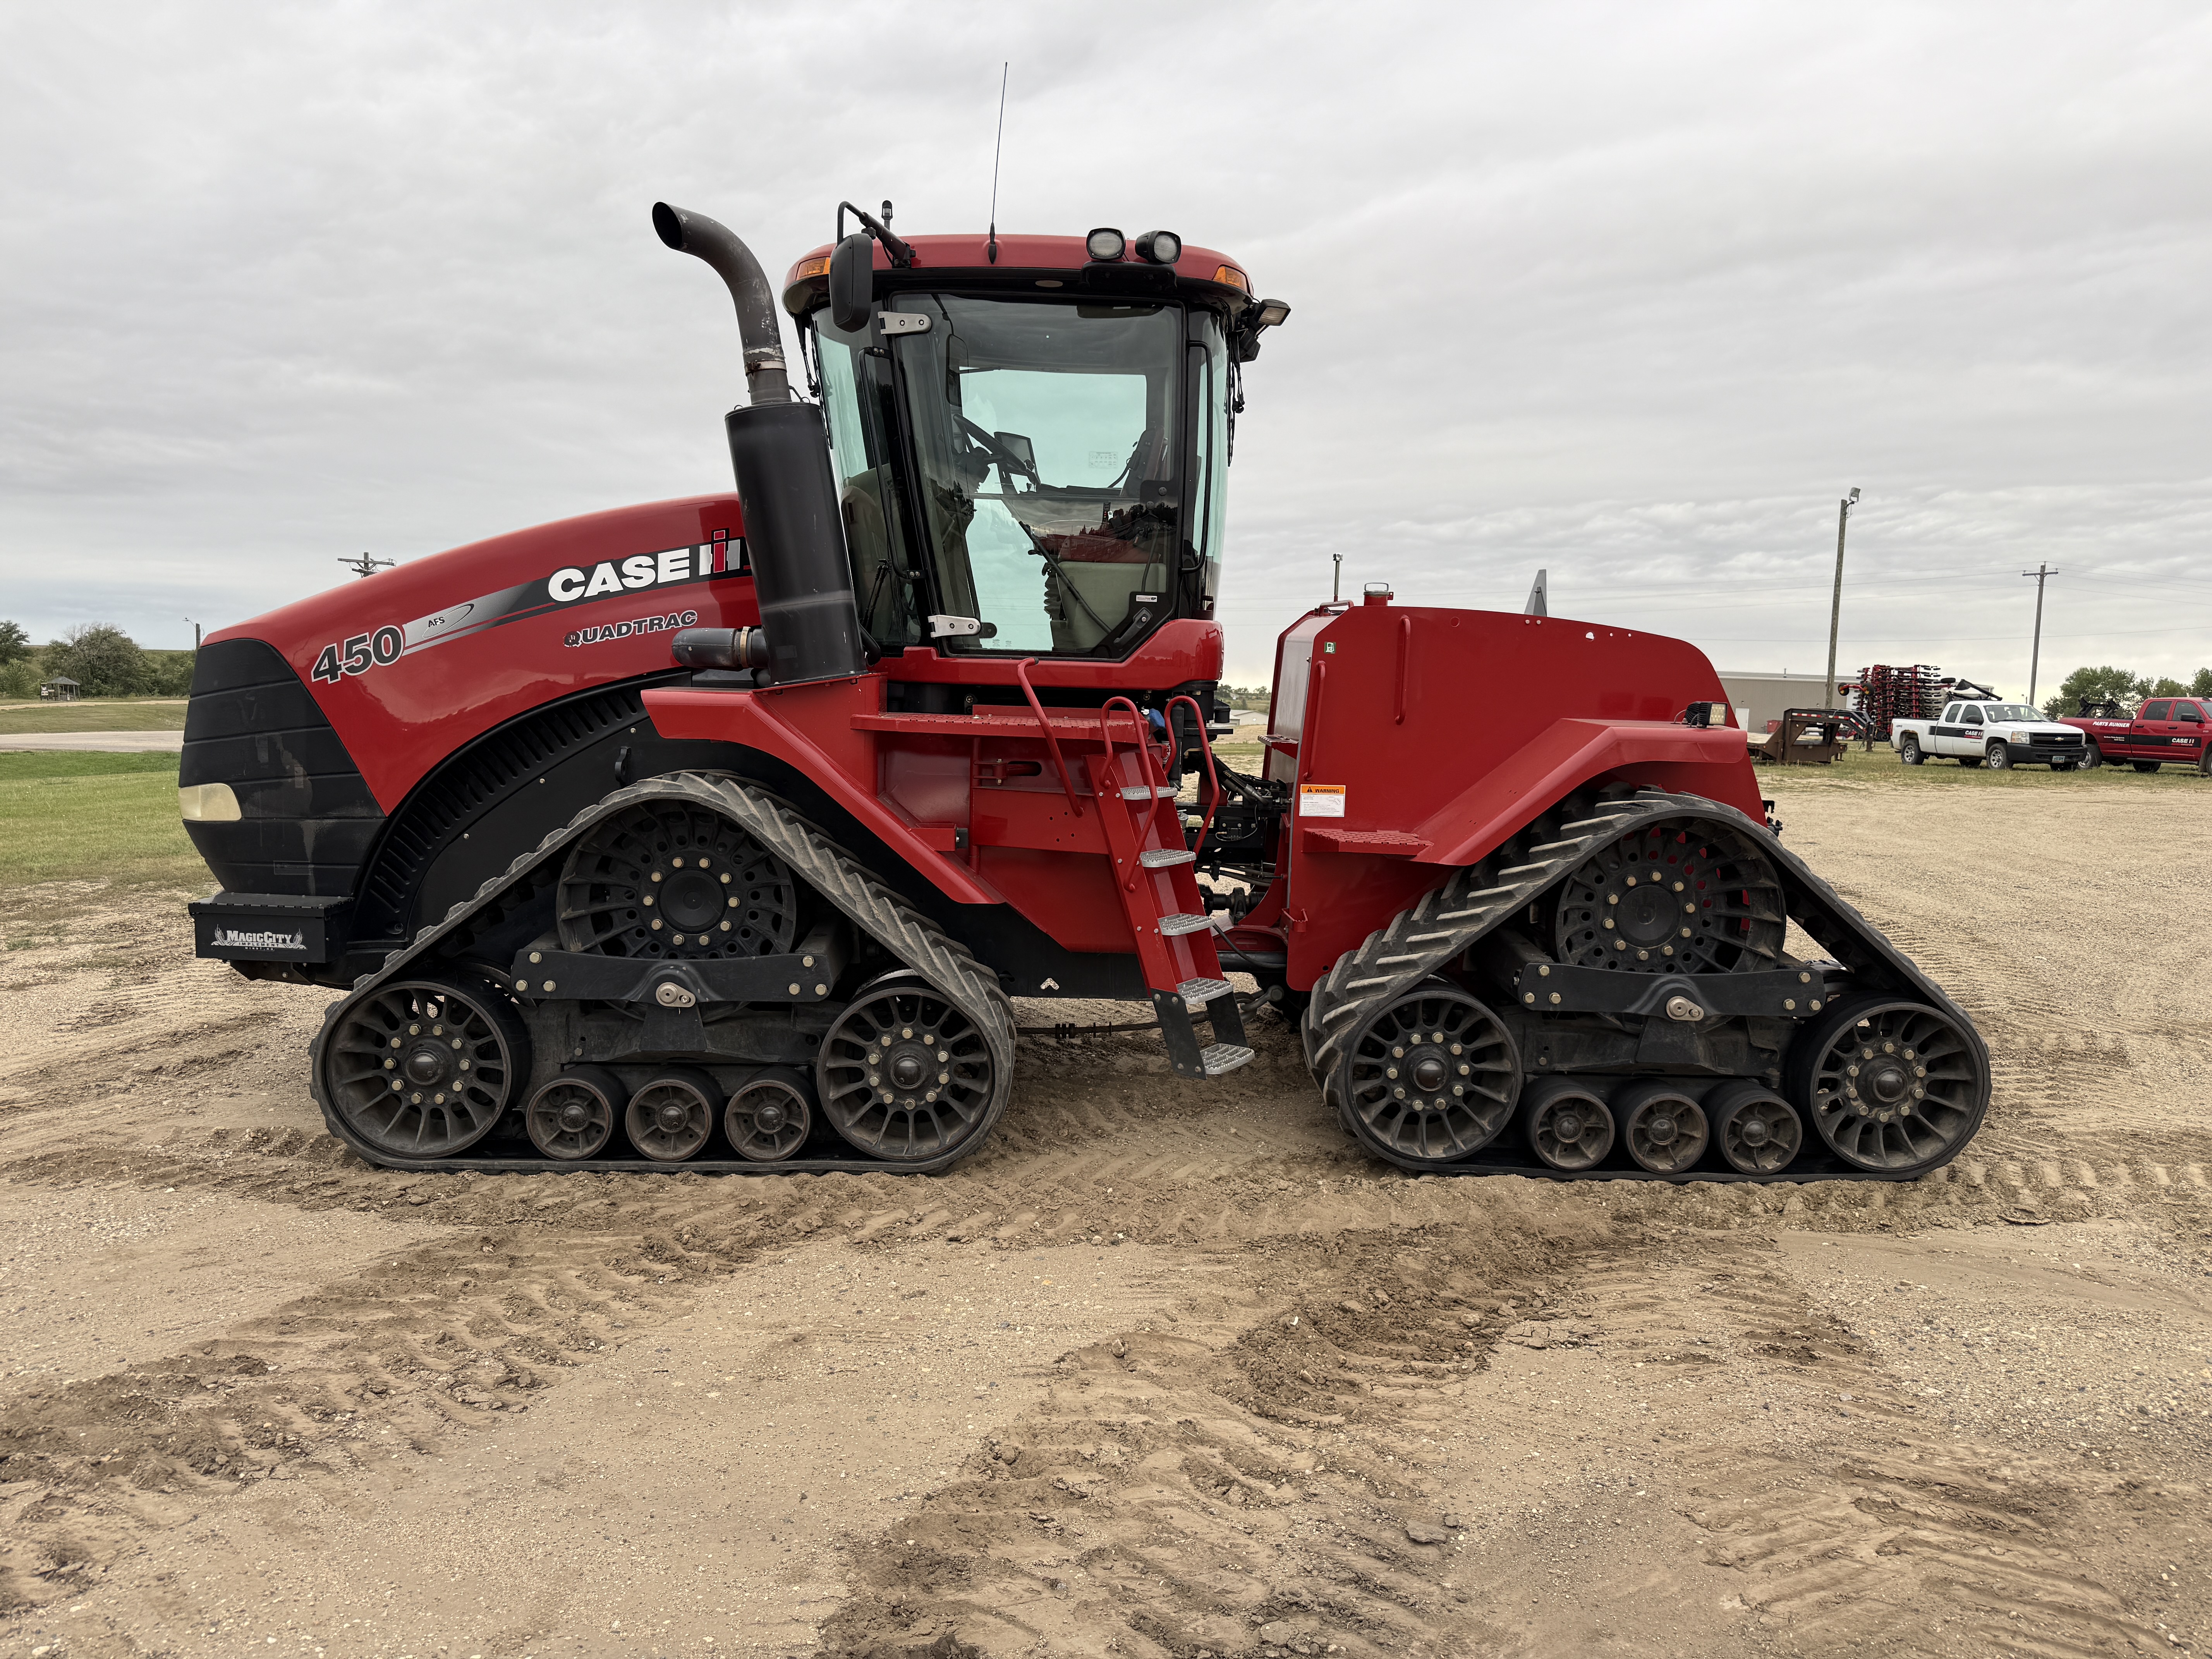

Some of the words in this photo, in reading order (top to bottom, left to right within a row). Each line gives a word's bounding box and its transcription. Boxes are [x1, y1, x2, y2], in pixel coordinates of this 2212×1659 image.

[548, 548, 690, 602] CASE
[428, 617, 445, 628] AFS
[563, 610, 698, 647] QUADTRAC
[311, 625, 404, 684] 450
